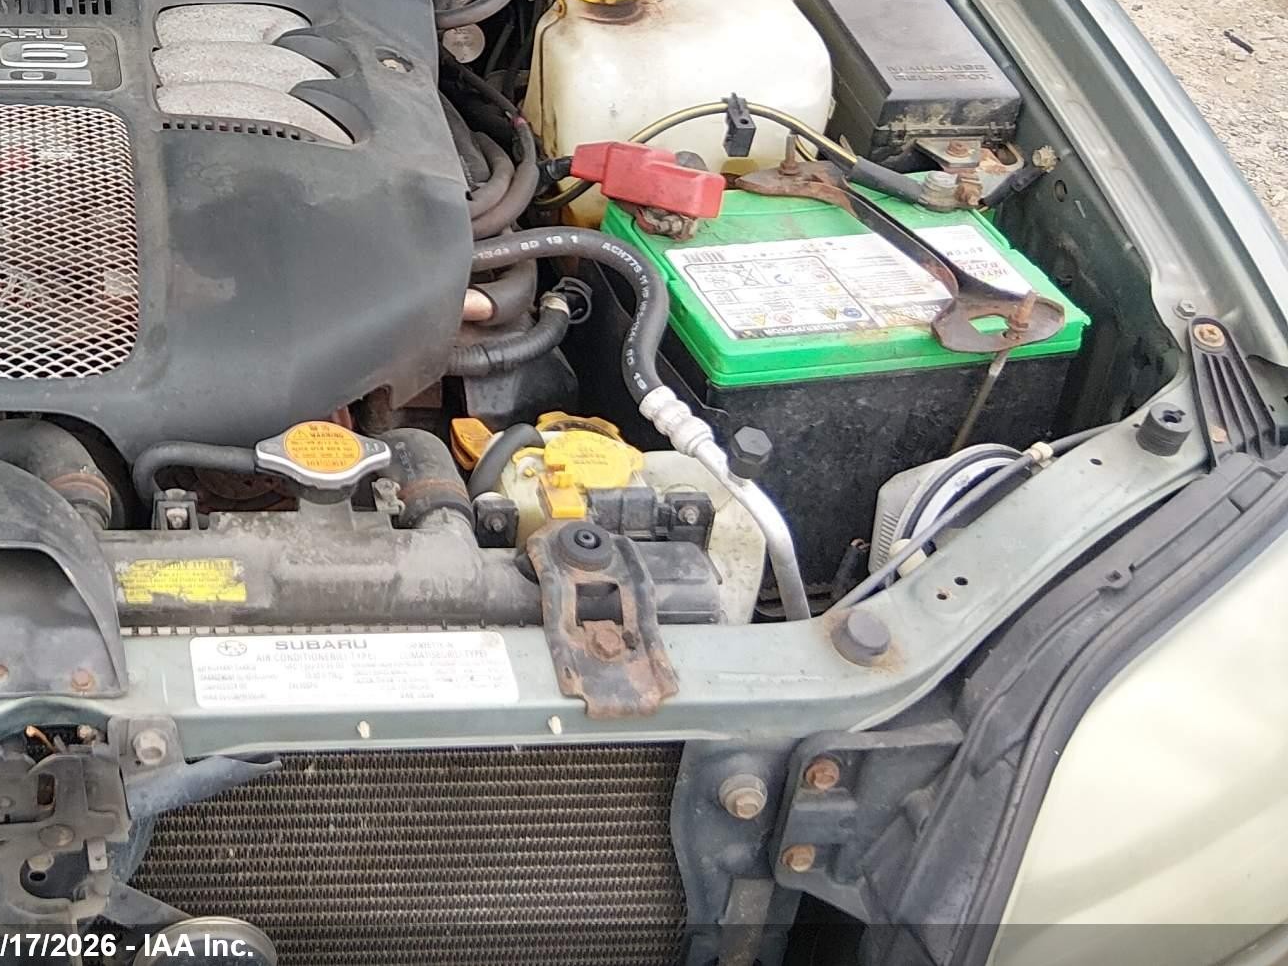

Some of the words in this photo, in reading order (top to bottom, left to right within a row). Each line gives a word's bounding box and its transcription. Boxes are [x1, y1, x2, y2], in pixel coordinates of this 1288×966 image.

[570, 234, 579, 244] 1
[275, 639, 367, 650] SUBARU
[256, 653, 271, 662] AIR
